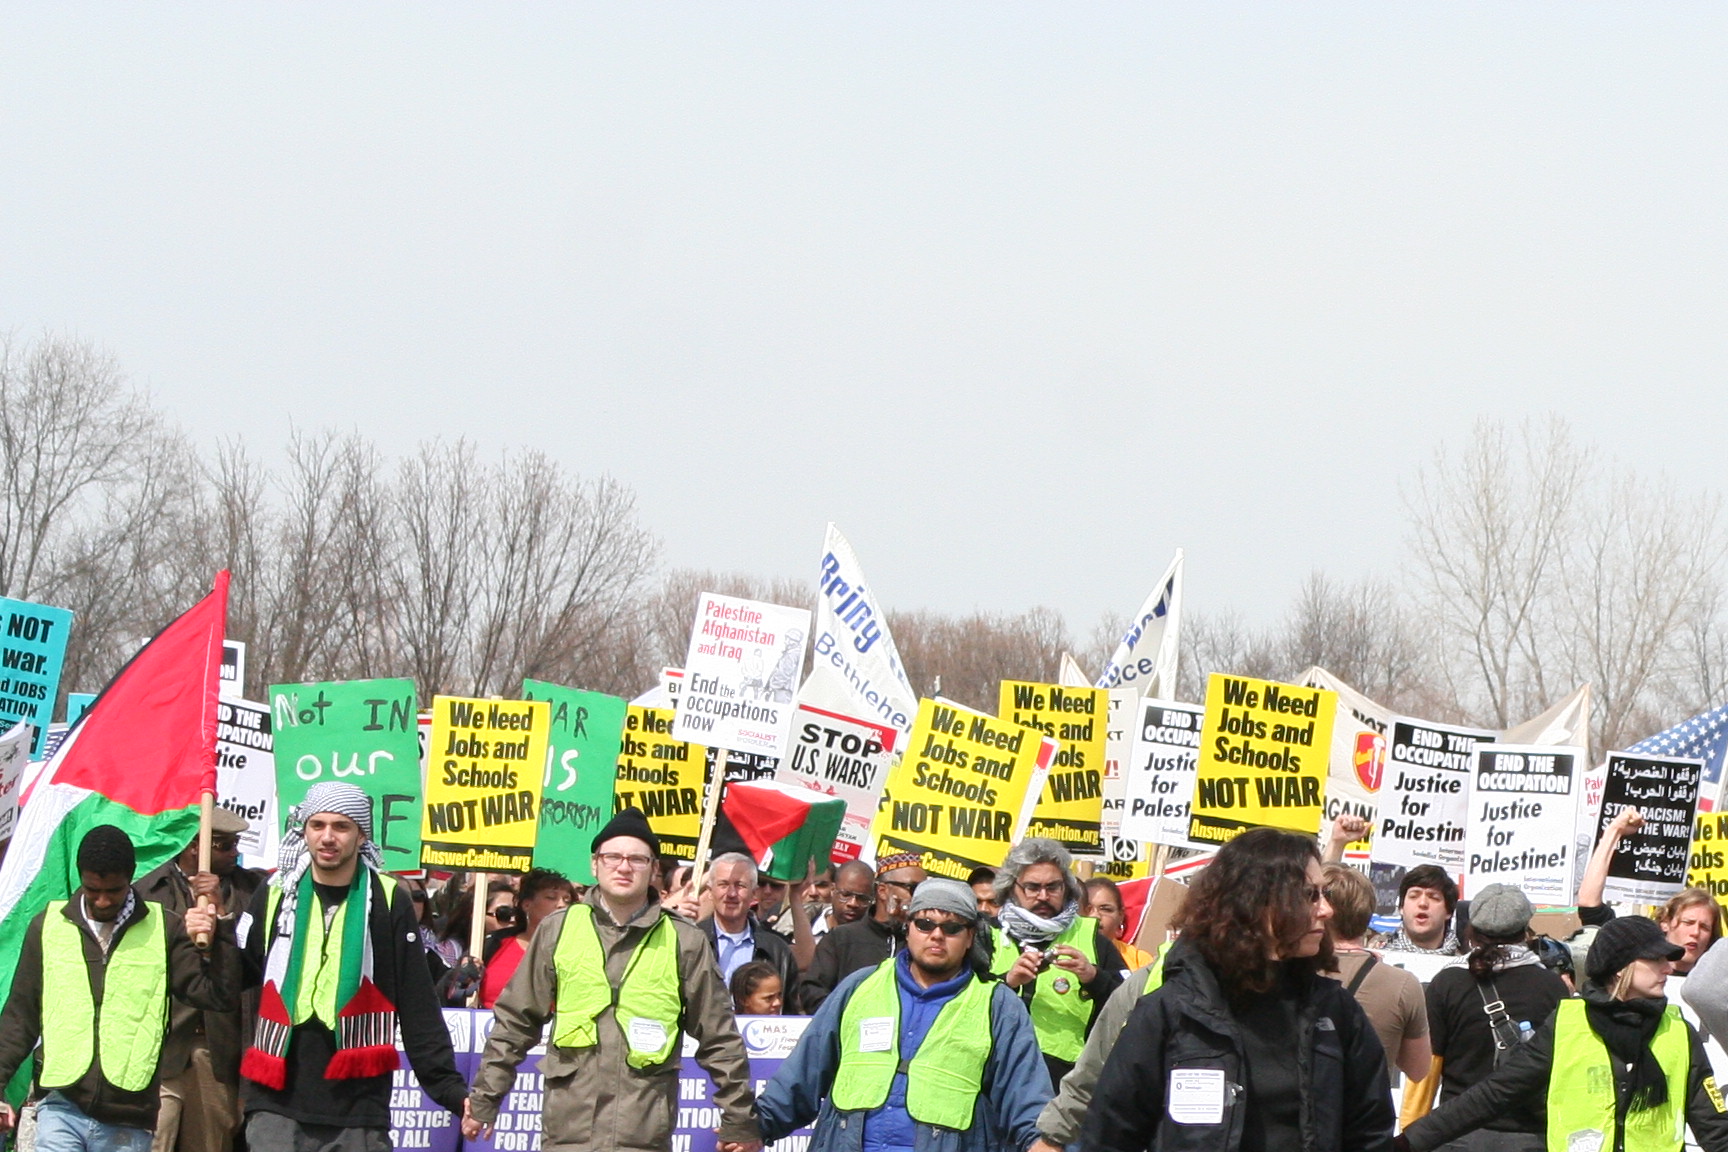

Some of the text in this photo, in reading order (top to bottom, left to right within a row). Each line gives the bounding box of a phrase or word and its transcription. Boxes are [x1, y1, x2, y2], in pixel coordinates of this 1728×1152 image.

[705, 600, 762, 625] Palestine
[7, 613, 54, 644] NOT
[701, 619, 776, 647] Afghanistan
[1, 647, 48, 676] war.
[697, 641, 743, 663] and Iraq
[12, 682, 47, 700] JOBS
[690, 672, 719, 695] End
[719, 684, 736, 699] the
[1223, 678, 1319, 718] We Need
[0, 700, 38, 718] ATION
[275, 691, 332, 731] Not
[363, 695, 411, 733] IN
[686, 696, 778, 725] occupations
[1013, 685, 1096, 715] We Need
[236, 708, 262, 730] THE
[450, 701, 534, 731] We Need
[626, 713, 639, 731] e
[682, 713, 715, 732] now
[1162, 710, 1193, 730] END
[1217, 708, 1315, 747] Jobs and
[217, 722, 274, 751] PATION
[800, 723, 883, 757] STOP
[930, 706, 1025, 755] We Need
[1059, 718, 1094, 743] and
[1144, 725, 1200, 750] OCCUPA
[1412, 729, 1476, 753] END THE
[216, 747, 247, 769] tice
[445, 730, 530, 761] Jobs and
[620, 733, 690, 762] obs and
[920, 734, 1016, 782] Jobs and
[1053, 745, 1085, 769] ools
[1213, 736, 1301, 773] Schools
[1394, 744, 1472, 770] OCCUPATIO
[296, 750, 394, 780] our
[543, 744, 579, 792] IS
[616, 759, 680, 786] chools
[791, 744, 820, 777] U.S.
[824, 756, 878, 790] WARS!
[1144, 752, 1196, 772] Justic
[1496, 754, 1555, 772] END THE
[442, 760, 518, 790] Schools
[912, 761, 998, 807] Schools
[1048, 769, 1103, 804] WAR
[1151, 774, 1178, 795] for
[1394, 771, 1461, 794] Justice
[1479, 773, 1569, 794] OCCUPATION
[639, 788, 699, 818] WAR
[1198, 776, 1321, 809] NOT WAR
[1401, 794, 1430, 816] for
[222, 799, 266, 821] tine!
[428, 799, 477, 835] NOT
[481, 791, 535, 828] WAR
[1131, 798, 1191, 818] Palest
[1480, 798, 1542, 823] Justice
[1640, 806, 1686, 823] RACISM!
[891, 800, 1013, 843] NOT WAR
[1382, 819, 1464, 842] Palestin
[1662, 824, 1690, 838] WAR!
[1023, 825, 1099, 845] erCoalition.org
[1487, 825, 1515, 847] for
[421, 845, 530, 873] AnswerCoalition.org
[1104, 861, 1134, 878] ools
[1469, 845, 1567, 875] Palestine!
[1690, 844, 1724, 870] obs
[763, 1025, 788, 1034] MAS
[679, 1078, 706, 1100] HE
[402, 1129, 431, 1148] ALL
[494, 1132, 528, 1150] FOR
